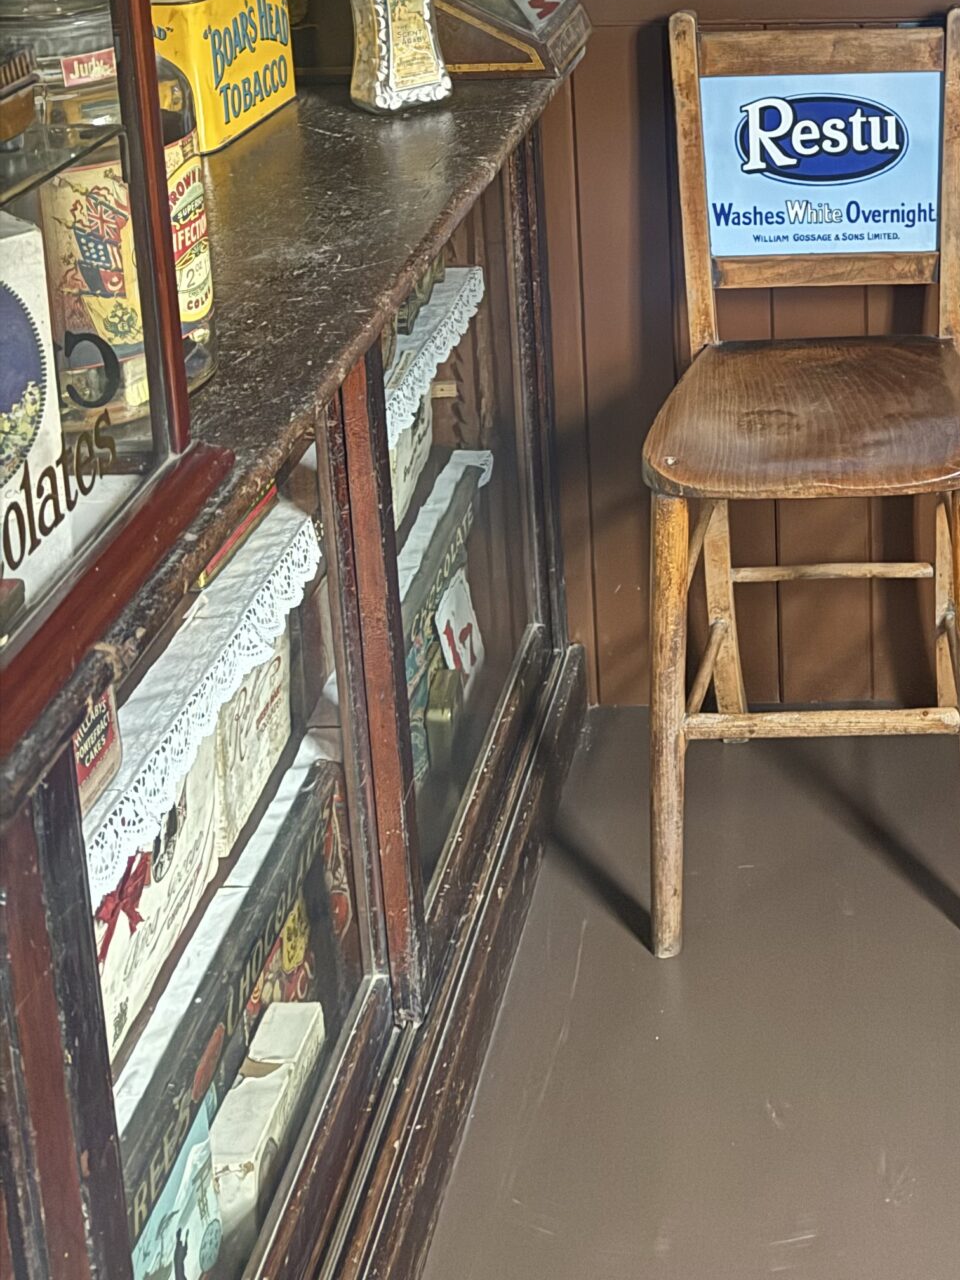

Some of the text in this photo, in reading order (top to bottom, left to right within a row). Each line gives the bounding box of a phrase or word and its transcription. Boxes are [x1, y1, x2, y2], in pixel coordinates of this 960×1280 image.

[219, 54, 288, 126] TOBACCO
[740, 97, 901, 174] Restu
[712, 202, 785, 226] Washes
[785, 199, 843, 225] White
[752, 231, 900, 242] WILLIAM GOSSAGE & SONS LIMITED.
[0, 408, 117, 571] olates
[77, 710, 110, 763] PONTEFRACT
[85, 734, 106, 767] CAKES
